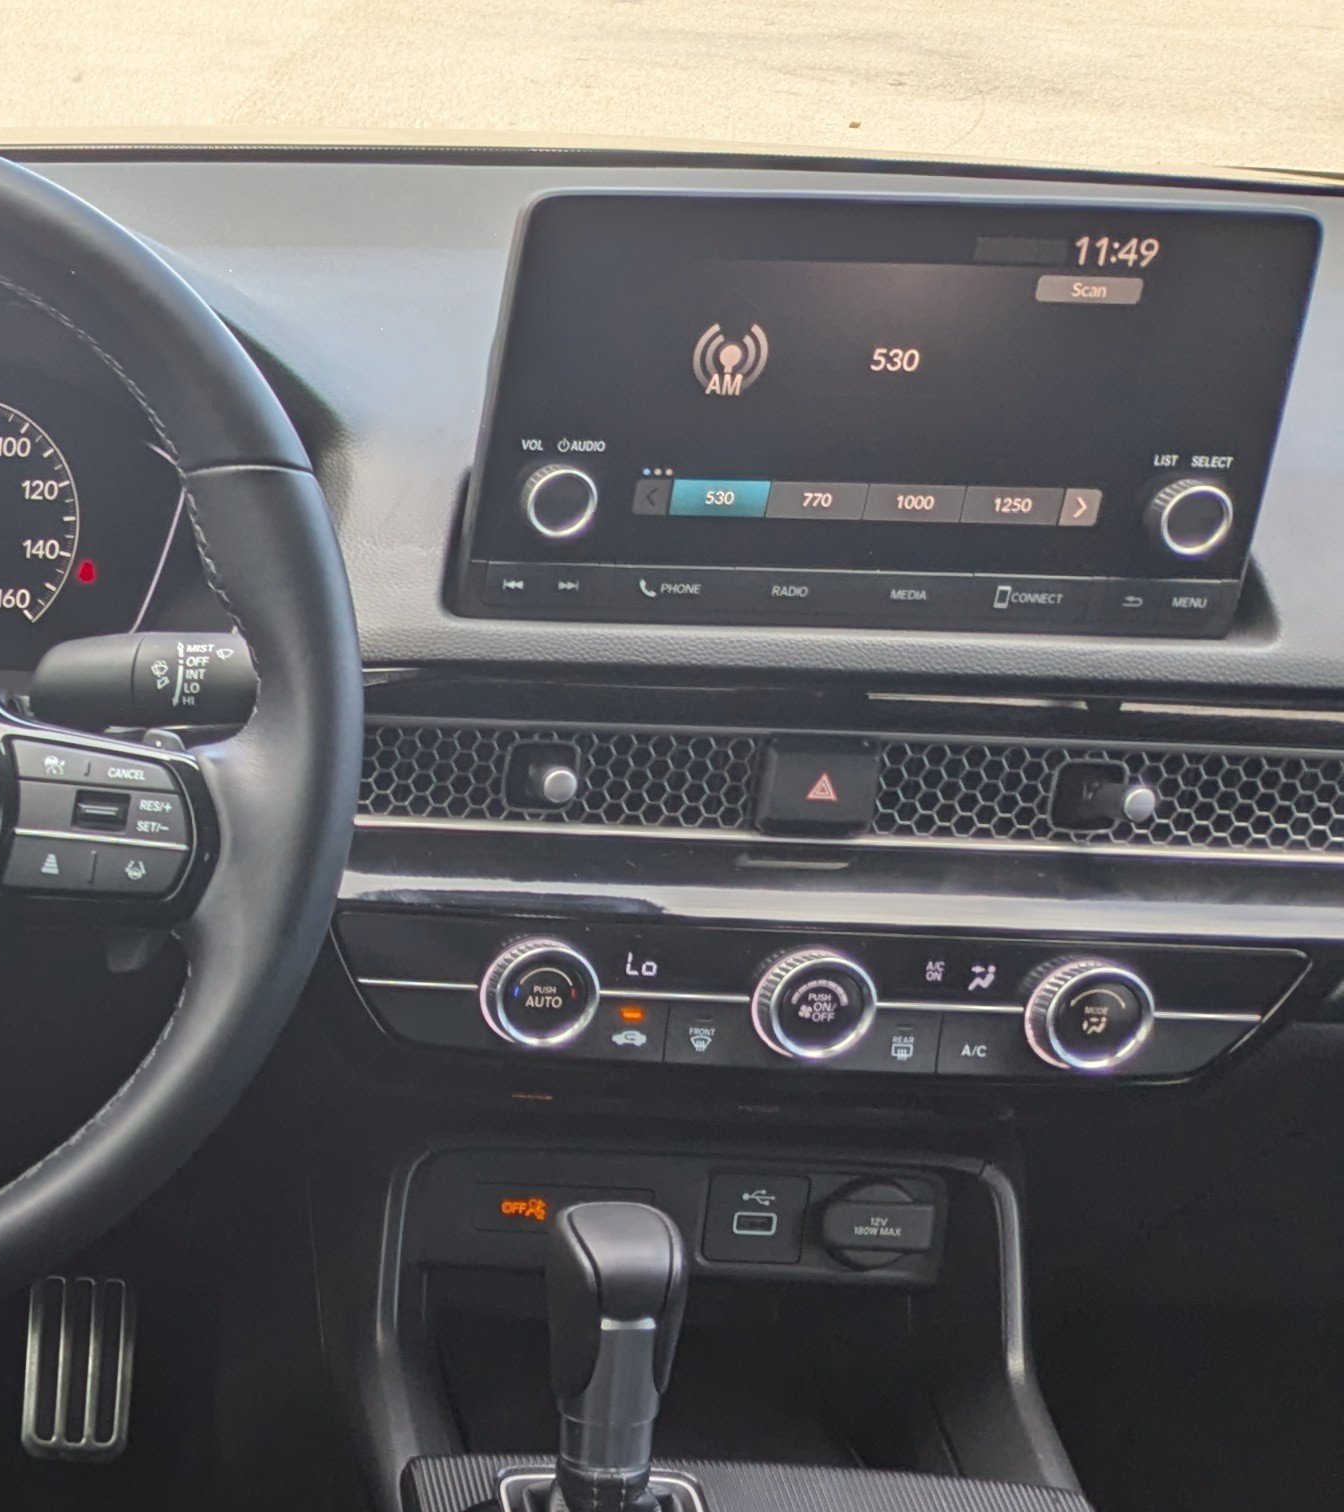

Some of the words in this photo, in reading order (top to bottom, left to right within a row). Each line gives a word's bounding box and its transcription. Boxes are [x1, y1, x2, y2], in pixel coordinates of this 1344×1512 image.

[1073, 236, 1160, 268] 11:49
[1072, 282, 1107, 298] Scan
[870, 348, 920, 373] 530
[706, 373, 744, 396] AM
[521, 438, 544, 451] VOL
[570, 440, 606, 452] AUDIO
[1154, 454, 1179, 467] LIST
[1191, 456, 1234, 469] SELECT
[22, 480, 58, 500] 120
[705, 490, 735, 506] 530
[802, 492, 832, 508] 770
[896, 494, 934, 511] 1000
[994, 496, 1032, 514] 1250
[22, 539, 60, 559] 140
[660, 583, 702, 596] PHONE
[772, 585, 808, 598] RADIO
[890, 588, 927, 601] MEDIA
[1011, 592, 1064, 606] CONNECT
[1172, 596, 1208, 610] MENU
[186, 644, 216, 652] MIST
[186, 656, 210, 667] OFF
[185, 668, 206, 680] INT
[184, 682, 200, 694] LO
[107, 767, 146, 780] CANCEL
[926, 961, 945, 972] A/C
[926, 971, 942, 982] ON
[534, 985, 556, 994] PUSH
[525, 996, 562, 1008] AUTO
[808, 992, 832, 1002] PUSH
[812, 1012, 835, 1022] OFF
[1084, 1006, 1108, 1015] MODE
[689, 1026, 715, 1036] FRONT
[892, 1035, 914, 1044] REAR
[962, 1044, 986, 1058] A/C
[502, 1200, 527, 1214] OFF
[870, 1216, 888, 1226] 12V
[854, 1226, 878, 1236] 180W
[880, 1227, 902, 1237] MAX
